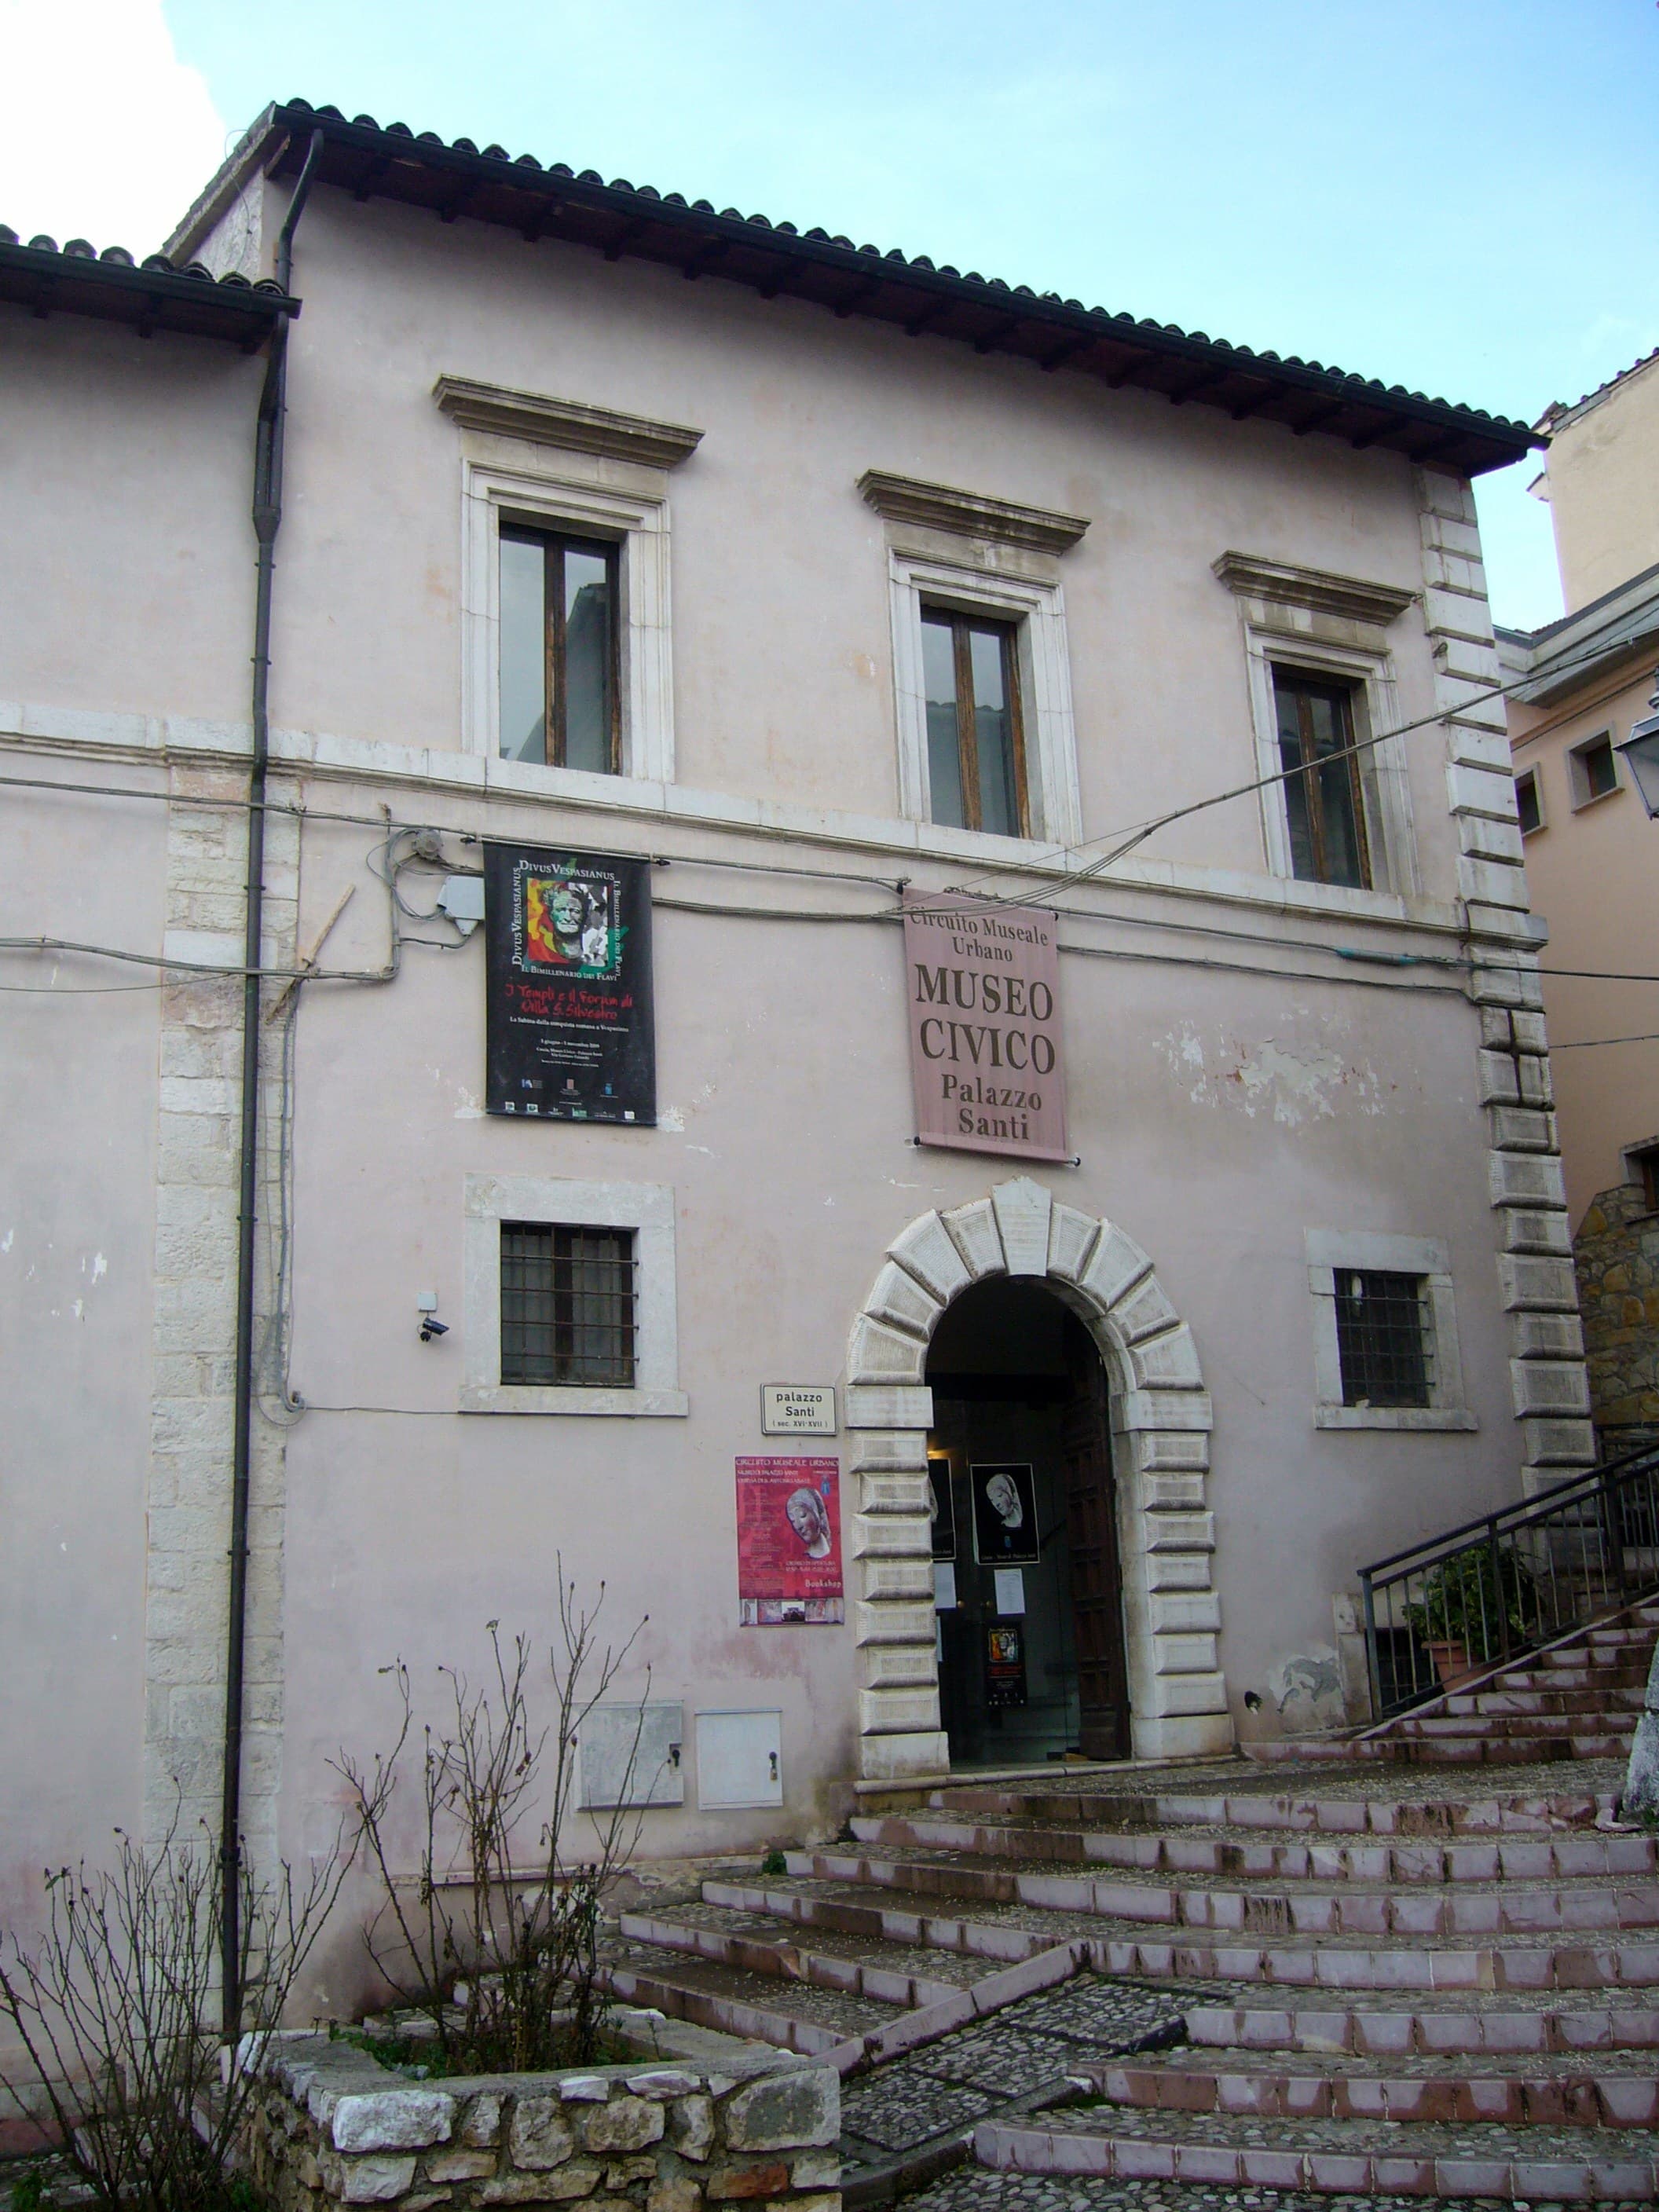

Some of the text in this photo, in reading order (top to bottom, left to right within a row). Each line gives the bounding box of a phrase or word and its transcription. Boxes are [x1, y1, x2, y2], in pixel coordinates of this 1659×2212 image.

[519, 859, 615, 881] DIVUS VESPASIANUS
[511, 866, 522, 965] DIVUS VESPASIANUS
[910, 906, 1049, 947] Circuito Museale
[952, 936, 1013, 962] Urbano
[914, 964, 1053, 1021] MUSEO
[920, 1018, 1056, 1075] CIVICO
[942, 1074, 1042, 1111] Palazzo
[958, 1108, 1030, 1140] Santi
[776, 1391, 822, 1403] palazzo
[786, 1406, 815, 1417] Santi
[805, 1579, 841, 1588] Bookshop
